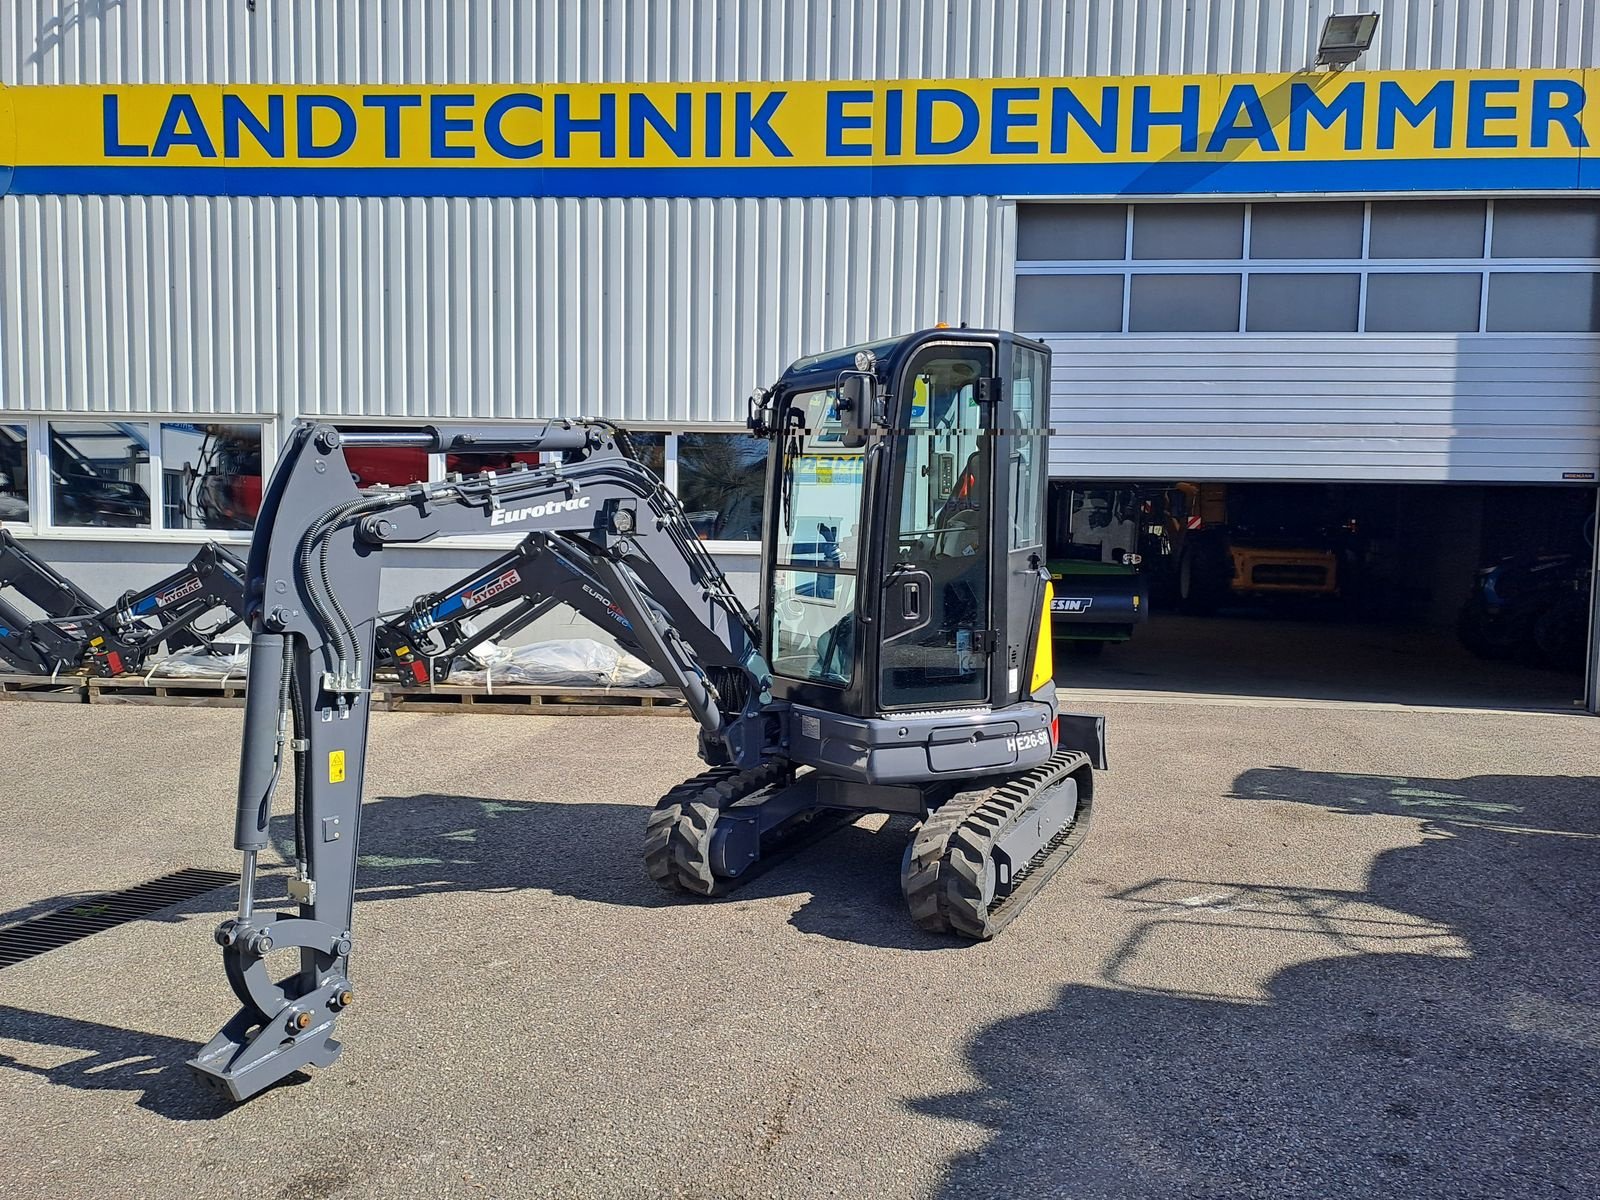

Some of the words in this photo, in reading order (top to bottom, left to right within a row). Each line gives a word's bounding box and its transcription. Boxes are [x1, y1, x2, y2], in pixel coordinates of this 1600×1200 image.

[102, 91, 794, 159] LANDTECHNIK
[824, 78, 1589, 158] EIDENHAMMER
[490, 496, 590, 526] Eurotrac
[164, 583, 201, 604] HYDRAC
[472, 576, 518, 605] HYDRAC
[606, 608, 629, 627] VITEC
